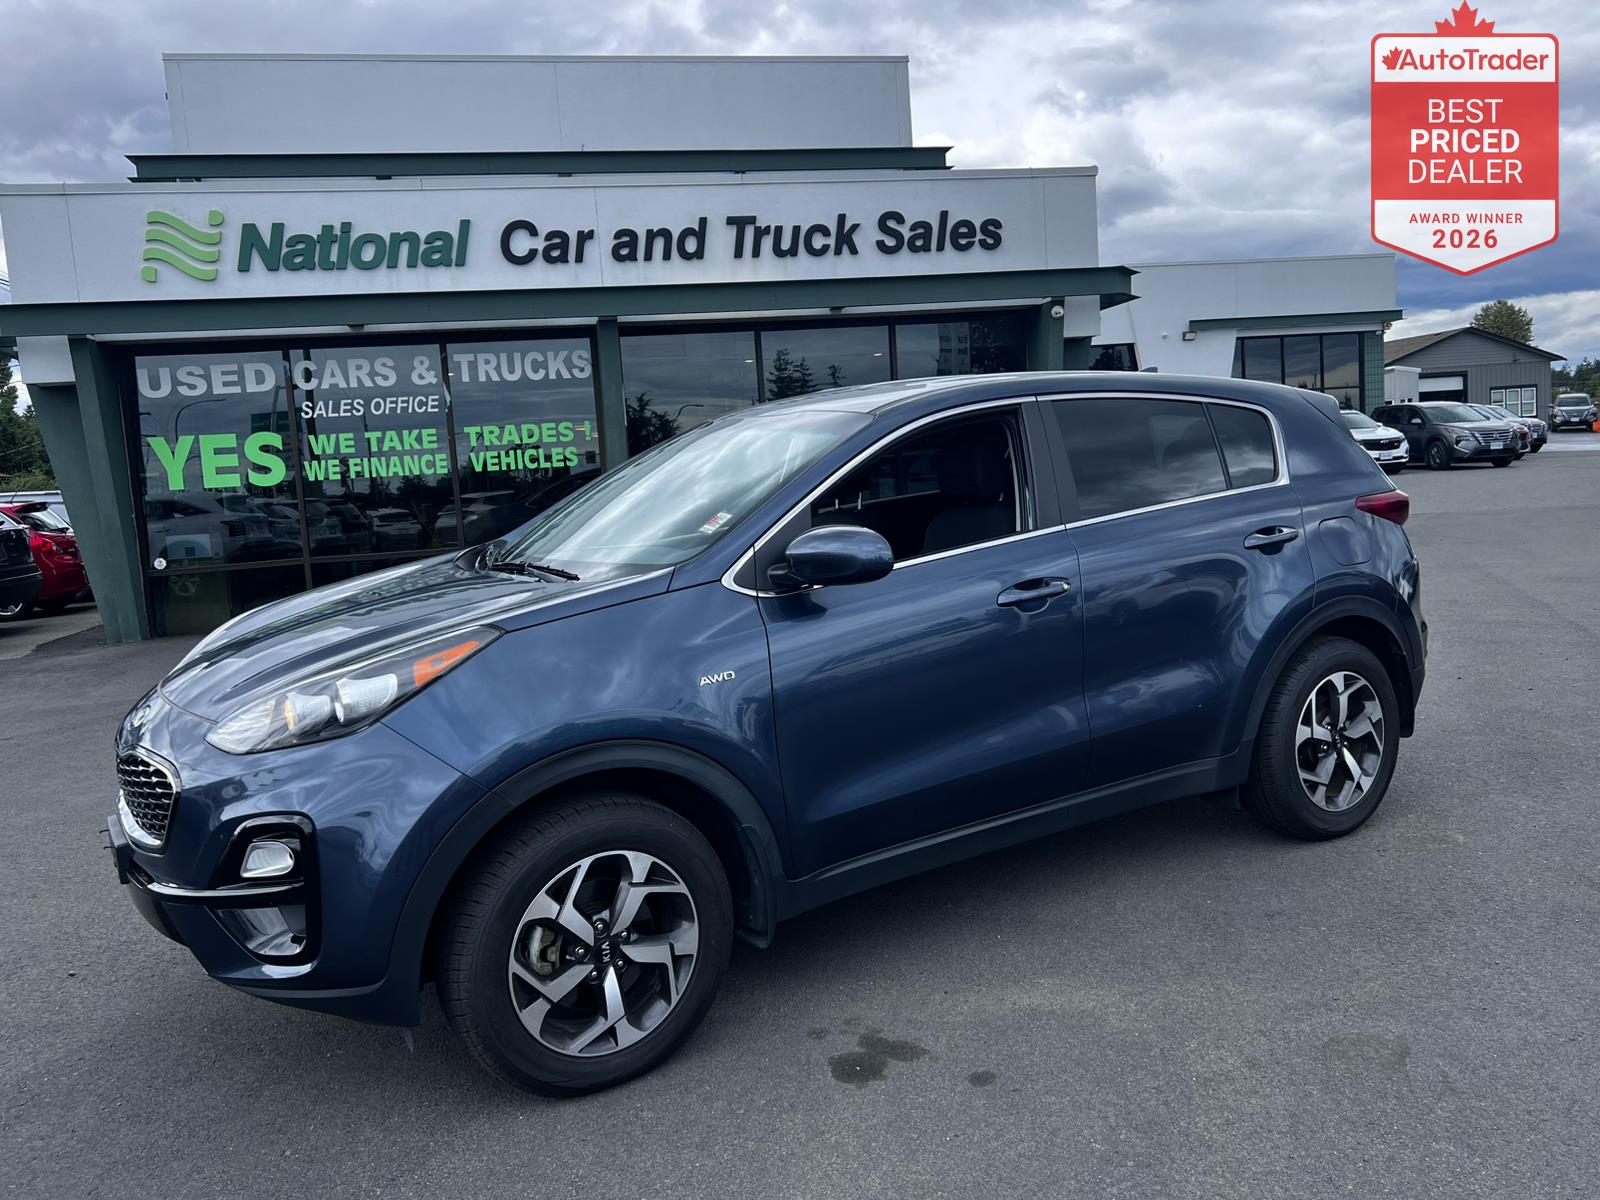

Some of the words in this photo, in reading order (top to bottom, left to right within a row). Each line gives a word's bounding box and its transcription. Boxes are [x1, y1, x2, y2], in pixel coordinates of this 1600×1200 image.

[237, 218, 471, 272] National
[500, 219, 595, 265] Car
[611, 217, 708, 262] and
[726, 213, 862, 260] Truck
[876, 210, 1004, 254] Sales
[135, 362, 276, 399] USED
[293, 357, 397, 390] CARS
[410, 355, 438, 385] &
[453, 350, 592, 382] TRUCKS
[300, 398, 364, 418] SALES
[370, 395, 440, 415] OFFICE
[308, 432, 356, 455] WE
[364, 428, 438, 452] TAKE
[464, 421, 575, 447] TRADES
[146, 431, 286, 491] YES
[303, 459, 342, 481] WE
[348, 453, 449, 479] FINANCE
[469, 446, 579, 472] VEHICLES
[699, 670, 735, 687] AWD
